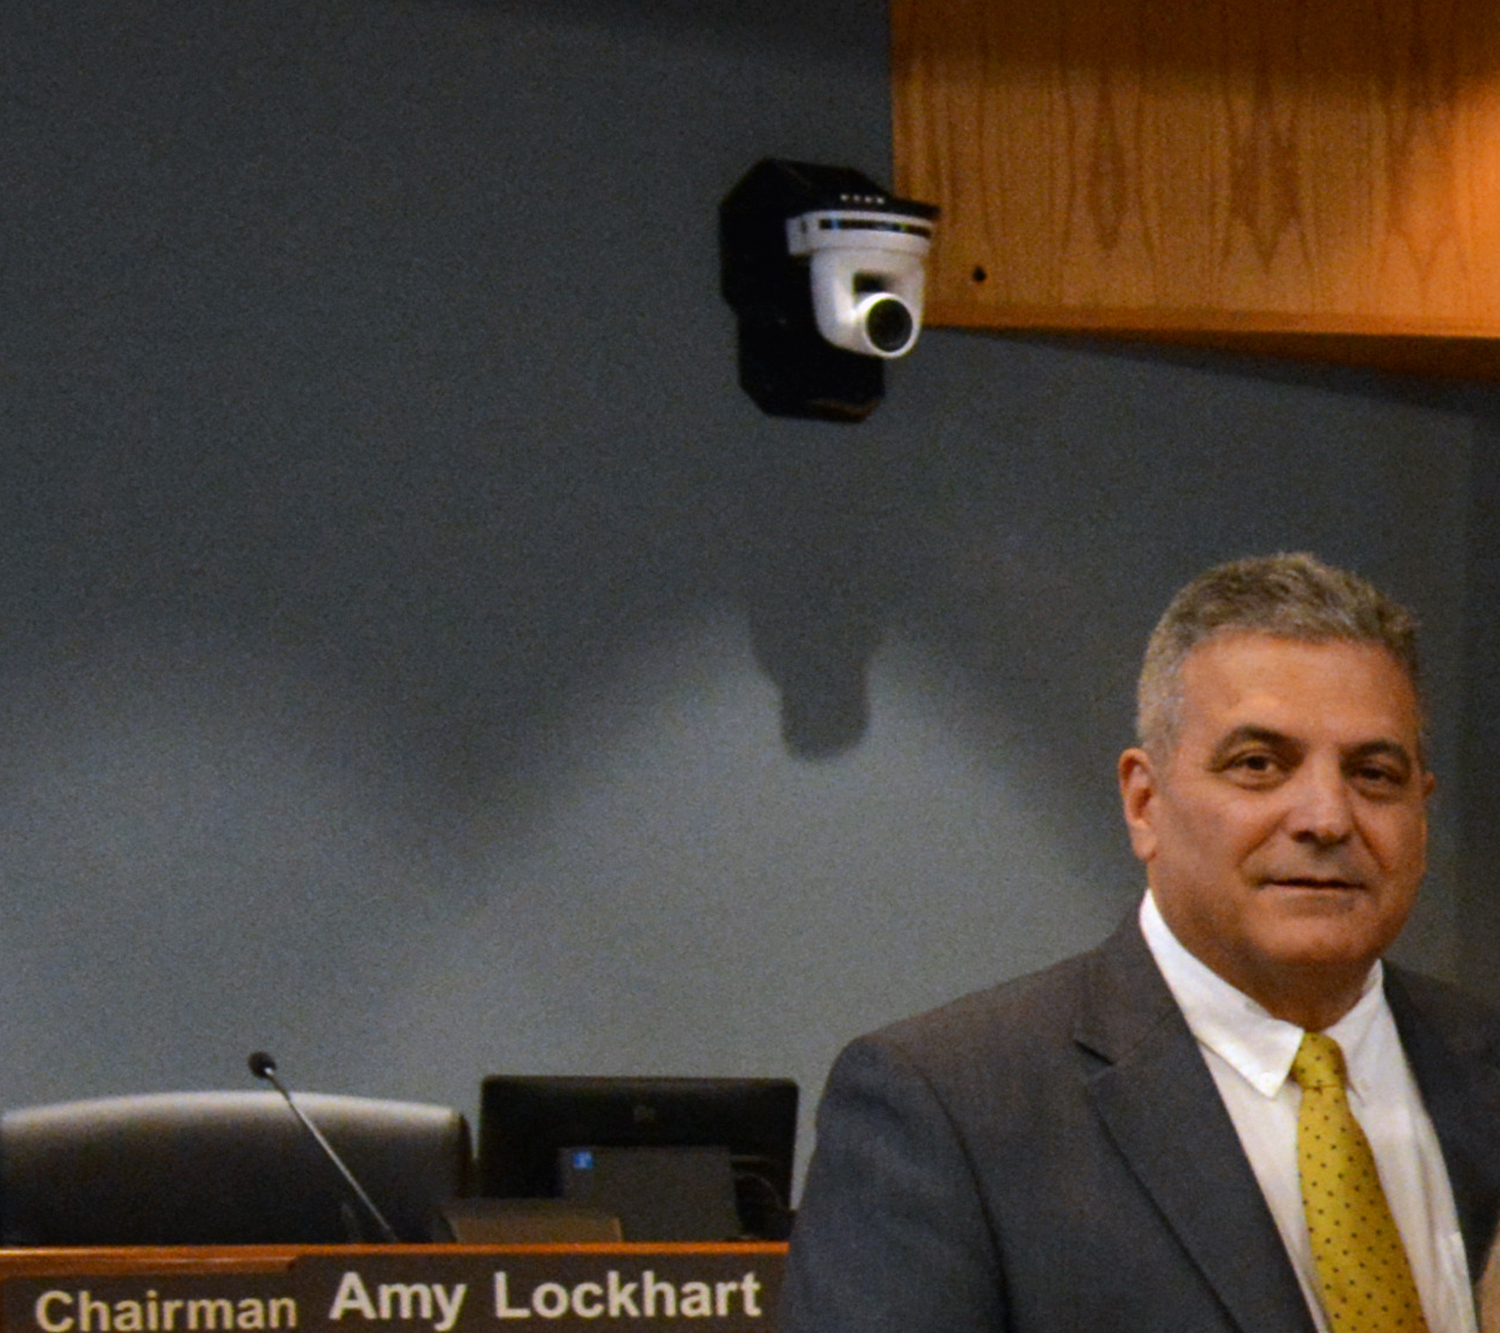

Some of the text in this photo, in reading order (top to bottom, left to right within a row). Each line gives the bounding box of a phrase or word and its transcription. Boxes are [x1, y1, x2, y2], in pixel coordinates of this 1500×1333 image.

[34, 1271, 762, 1333] Chairman Amy Lockhart
